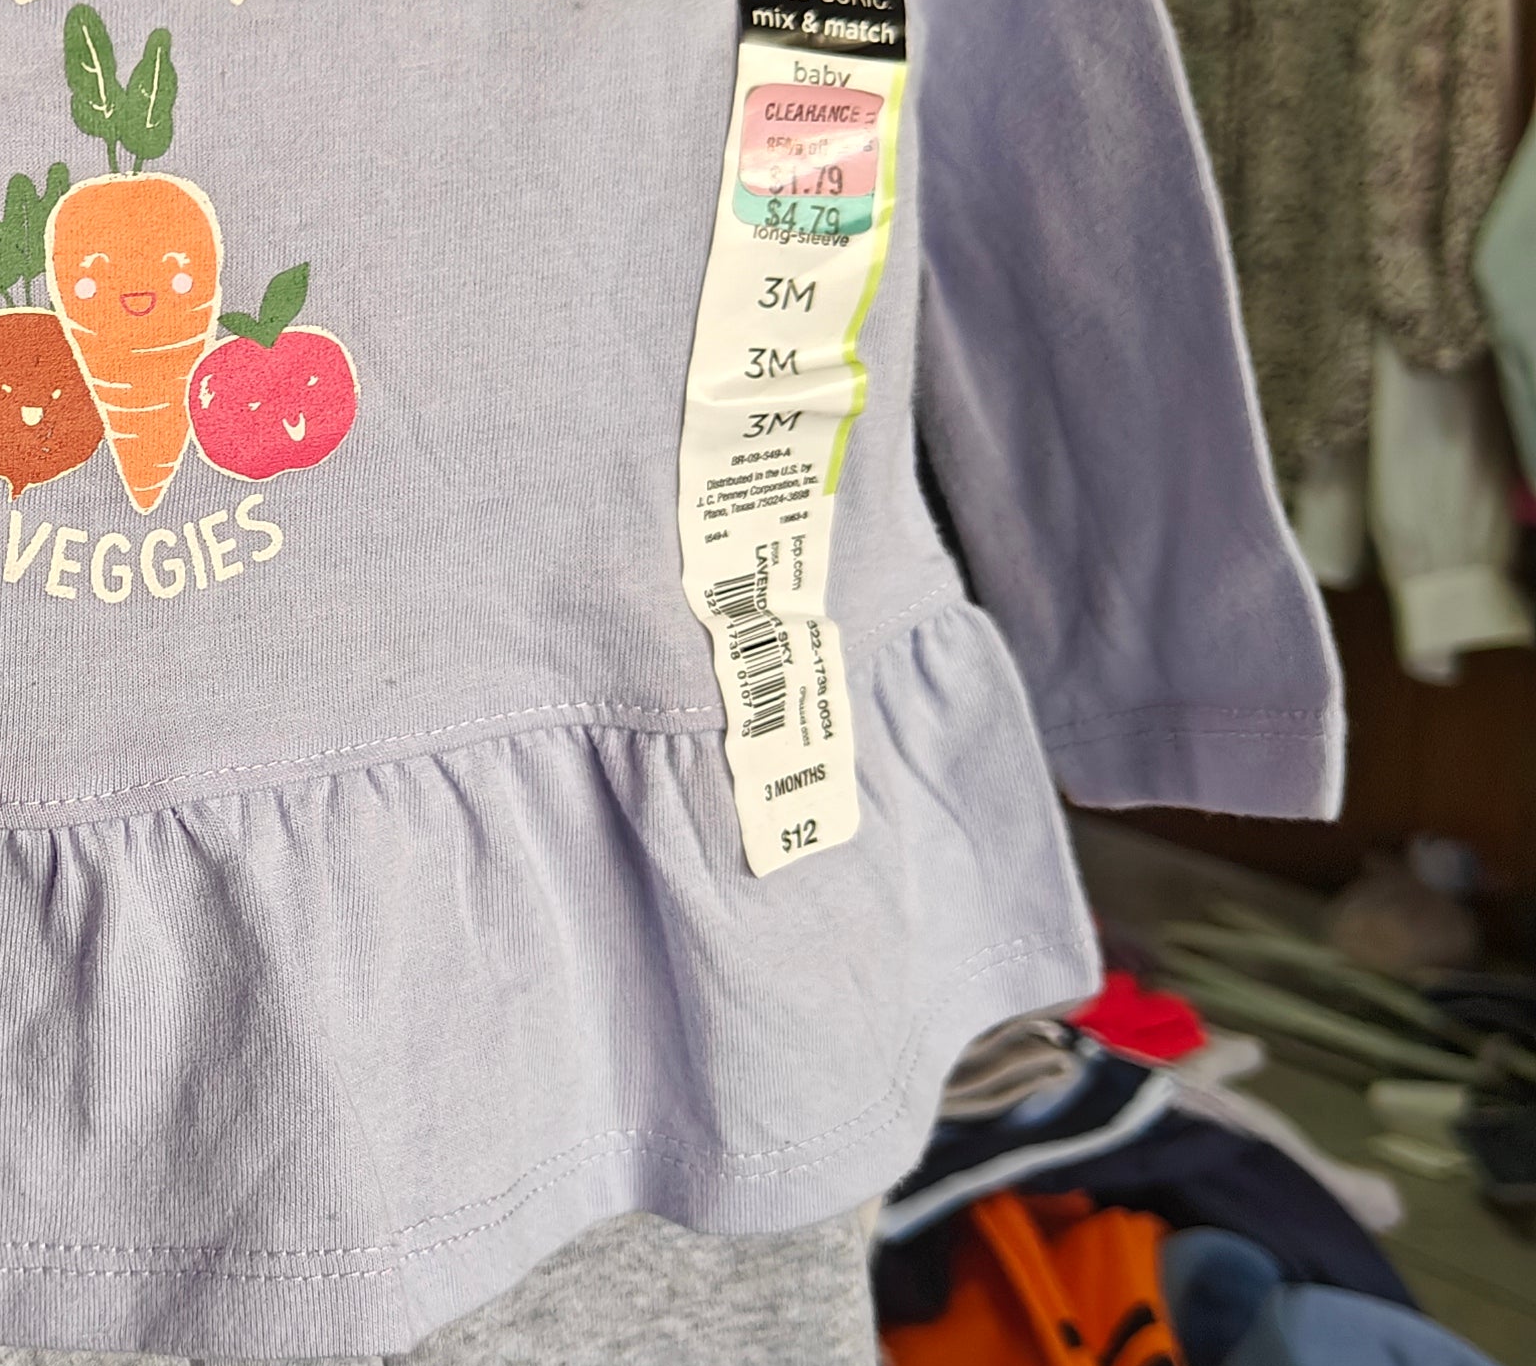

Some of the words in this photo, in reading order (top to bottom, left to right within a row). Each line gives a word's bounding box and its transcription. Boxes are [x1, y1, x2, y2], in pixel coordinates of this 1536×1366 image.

[752, 8, 795, 30] mix
[801, 10, 819, 33] &
[824, 18, 895, 45] match
[794, 60, 851, 87] baby
[765, 102, 861, 123] CLEARANCE
[765, 198, 841, 236] $4.79
[757, 277, 816, 313] 3M
[744, 348, 799, 379] 3M
[742, 411, 802, 438] 3M
[707, 473, 753, 491] Distributed
[765, 469, 779, 479] the
[781, 464, 798, 476] U.S.
[801, 463, 812, 473] by
[717, 490, 748, 503] Penney
[3, 494, 283, 603] VEGGIES
[704, 589, 722, 616] 322
[727, 623, 741, 661] 1738
[778, 630, 794, 665] SKY
[737, 670, 752, 708] 0107
[741, 718, 752, 737] 03
[817, 699, 833, 740] 0034
[764, 783, 773, 801] 3
[774, 763, 826, 797] MONTHS
[781, 818, 818, 853] $12
